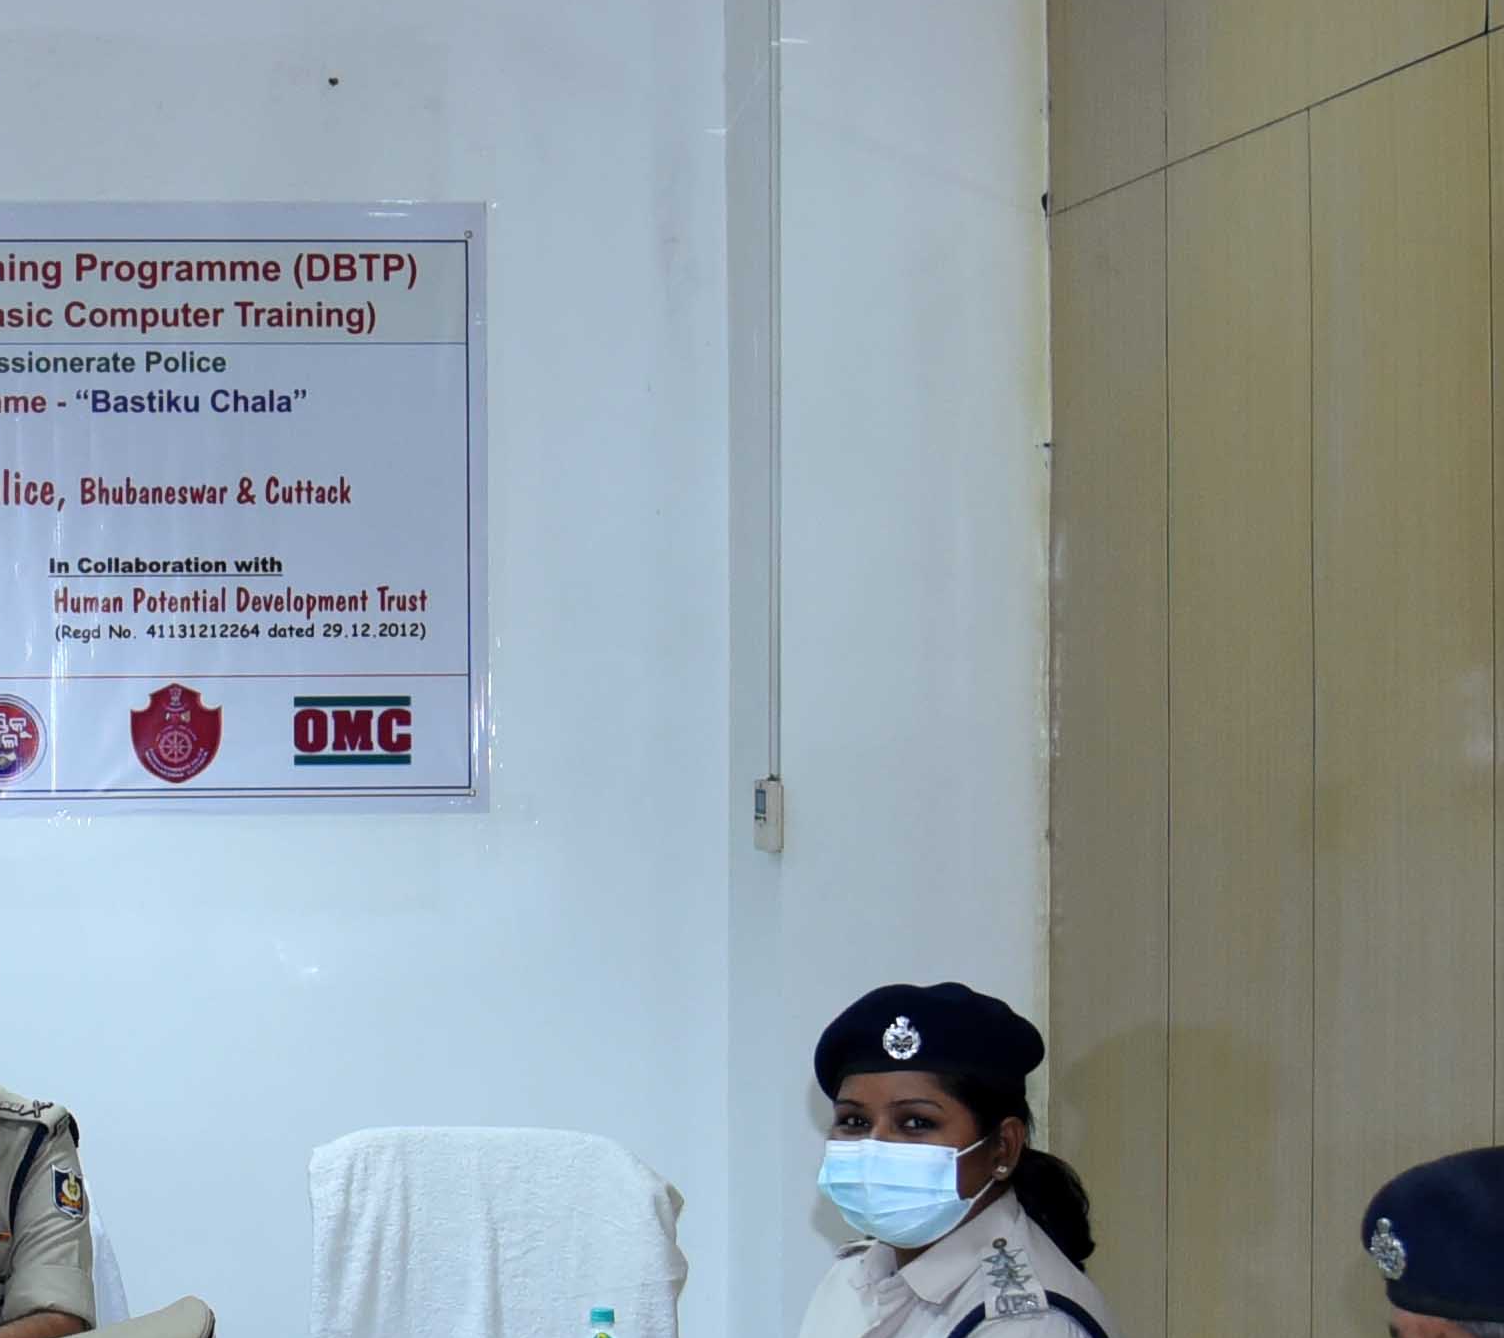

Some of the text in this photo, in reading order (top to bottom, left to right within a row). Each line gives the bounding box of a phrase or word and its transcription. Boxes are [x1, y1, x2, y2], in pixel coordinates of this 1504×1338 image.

[75, 253, 281, 289] Programme
[293, 253, 418, 289] (DBTP)
[64, 301, 224, 333] Computer
[234, 301, 377, 334] Training)
[145, 351, 227, 373] Police
[75, 390, 200, 413] “Bastiku
[210, 389, 307, 413] Chala”
[80, 477, 228, 505] Bhubaneswar
[236, 476, 256, 505] &
[265, 476, 351, 505] Cuttack
[49, 557, 283, 573] In Collaboration with
[54, 586, 428, 619] Human Potential Development Trust
[55, 622, 427, 643] (Regd No. 41131212264 dated 29.12.2012)
[294, 708, 411, 753] OMC
